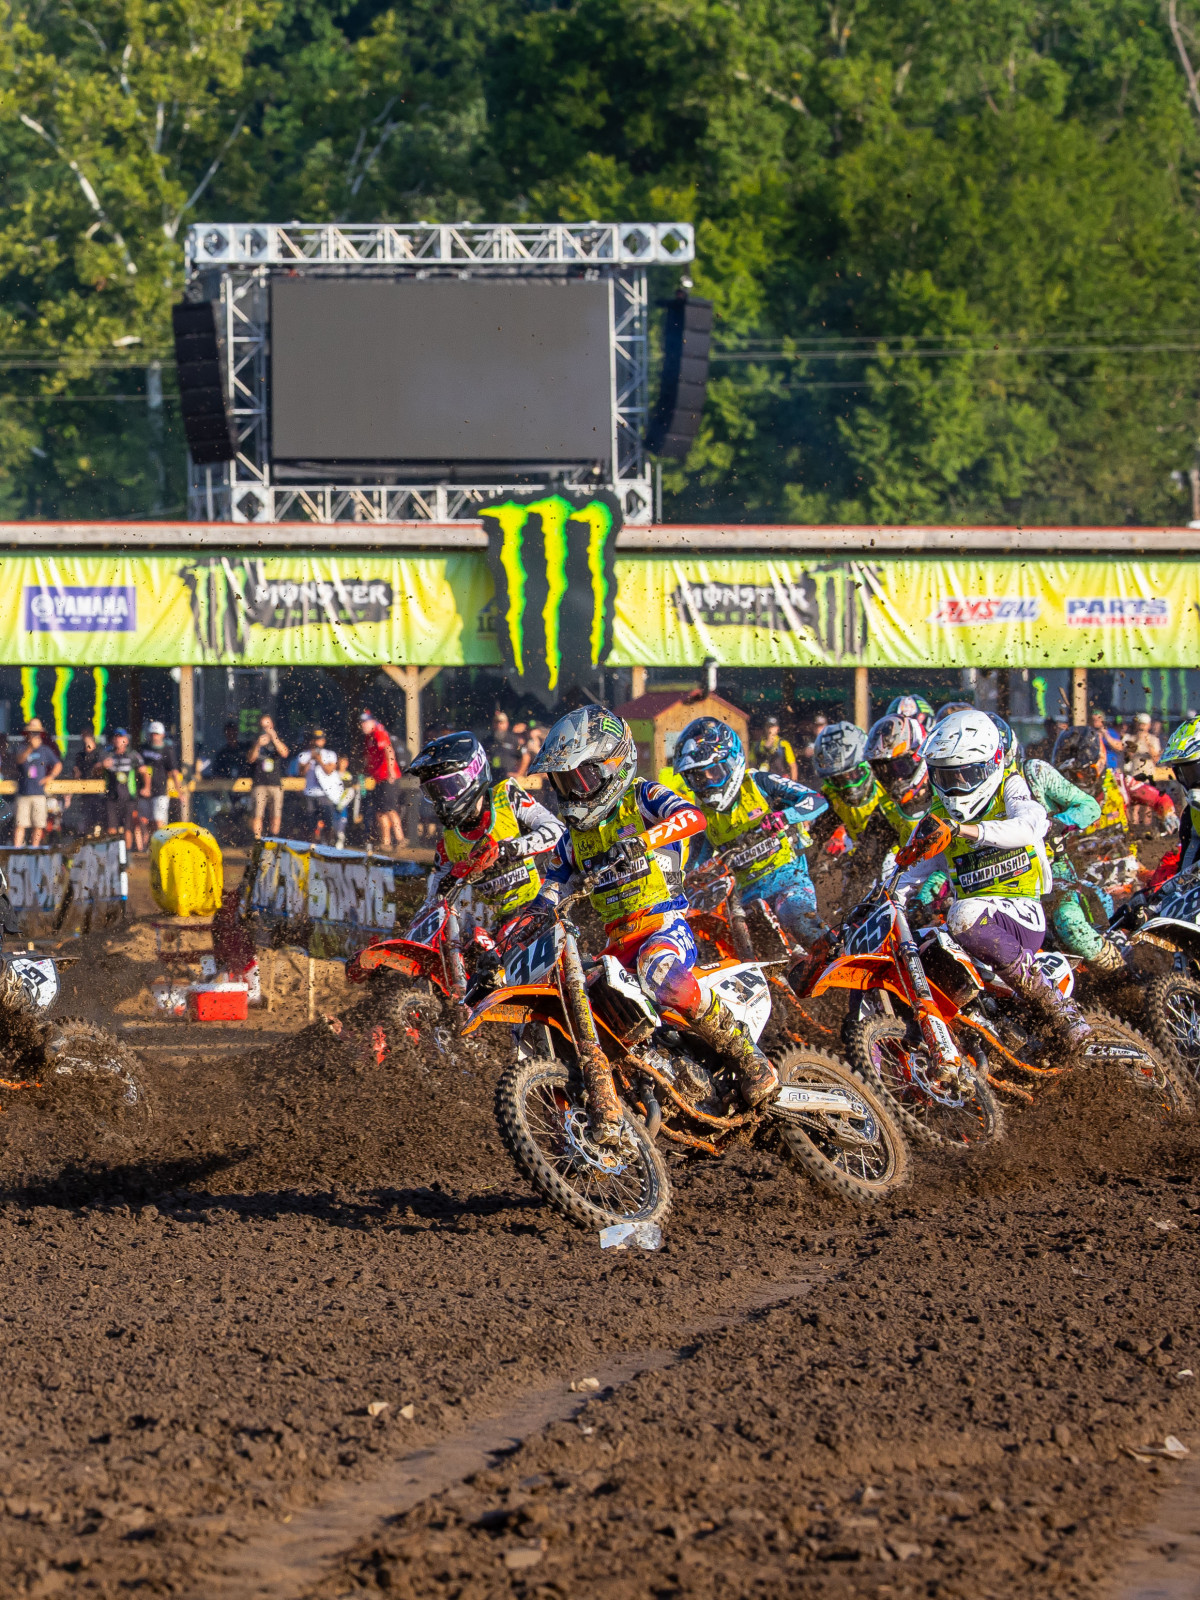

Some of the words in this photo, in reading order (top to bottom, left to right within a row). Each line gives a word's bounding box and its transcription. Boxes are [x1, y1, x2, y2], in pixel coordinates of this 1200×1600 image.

[54, 596, 129, 617] YAMAHA
[255, 583, 390, 607] MONSTER
[680, 585, 810, 611] MONSTER
[1068, 600, 1168, 615] PARTS
[1068, 616, 1168, 626] UNLIMITED
[649, 808, 699, 845] FXR
[960, 853, 1027, 887] CHAMPIONSHIP
[509, 928, 556, 986] 34
[720, 967, 767, 1003] 34
